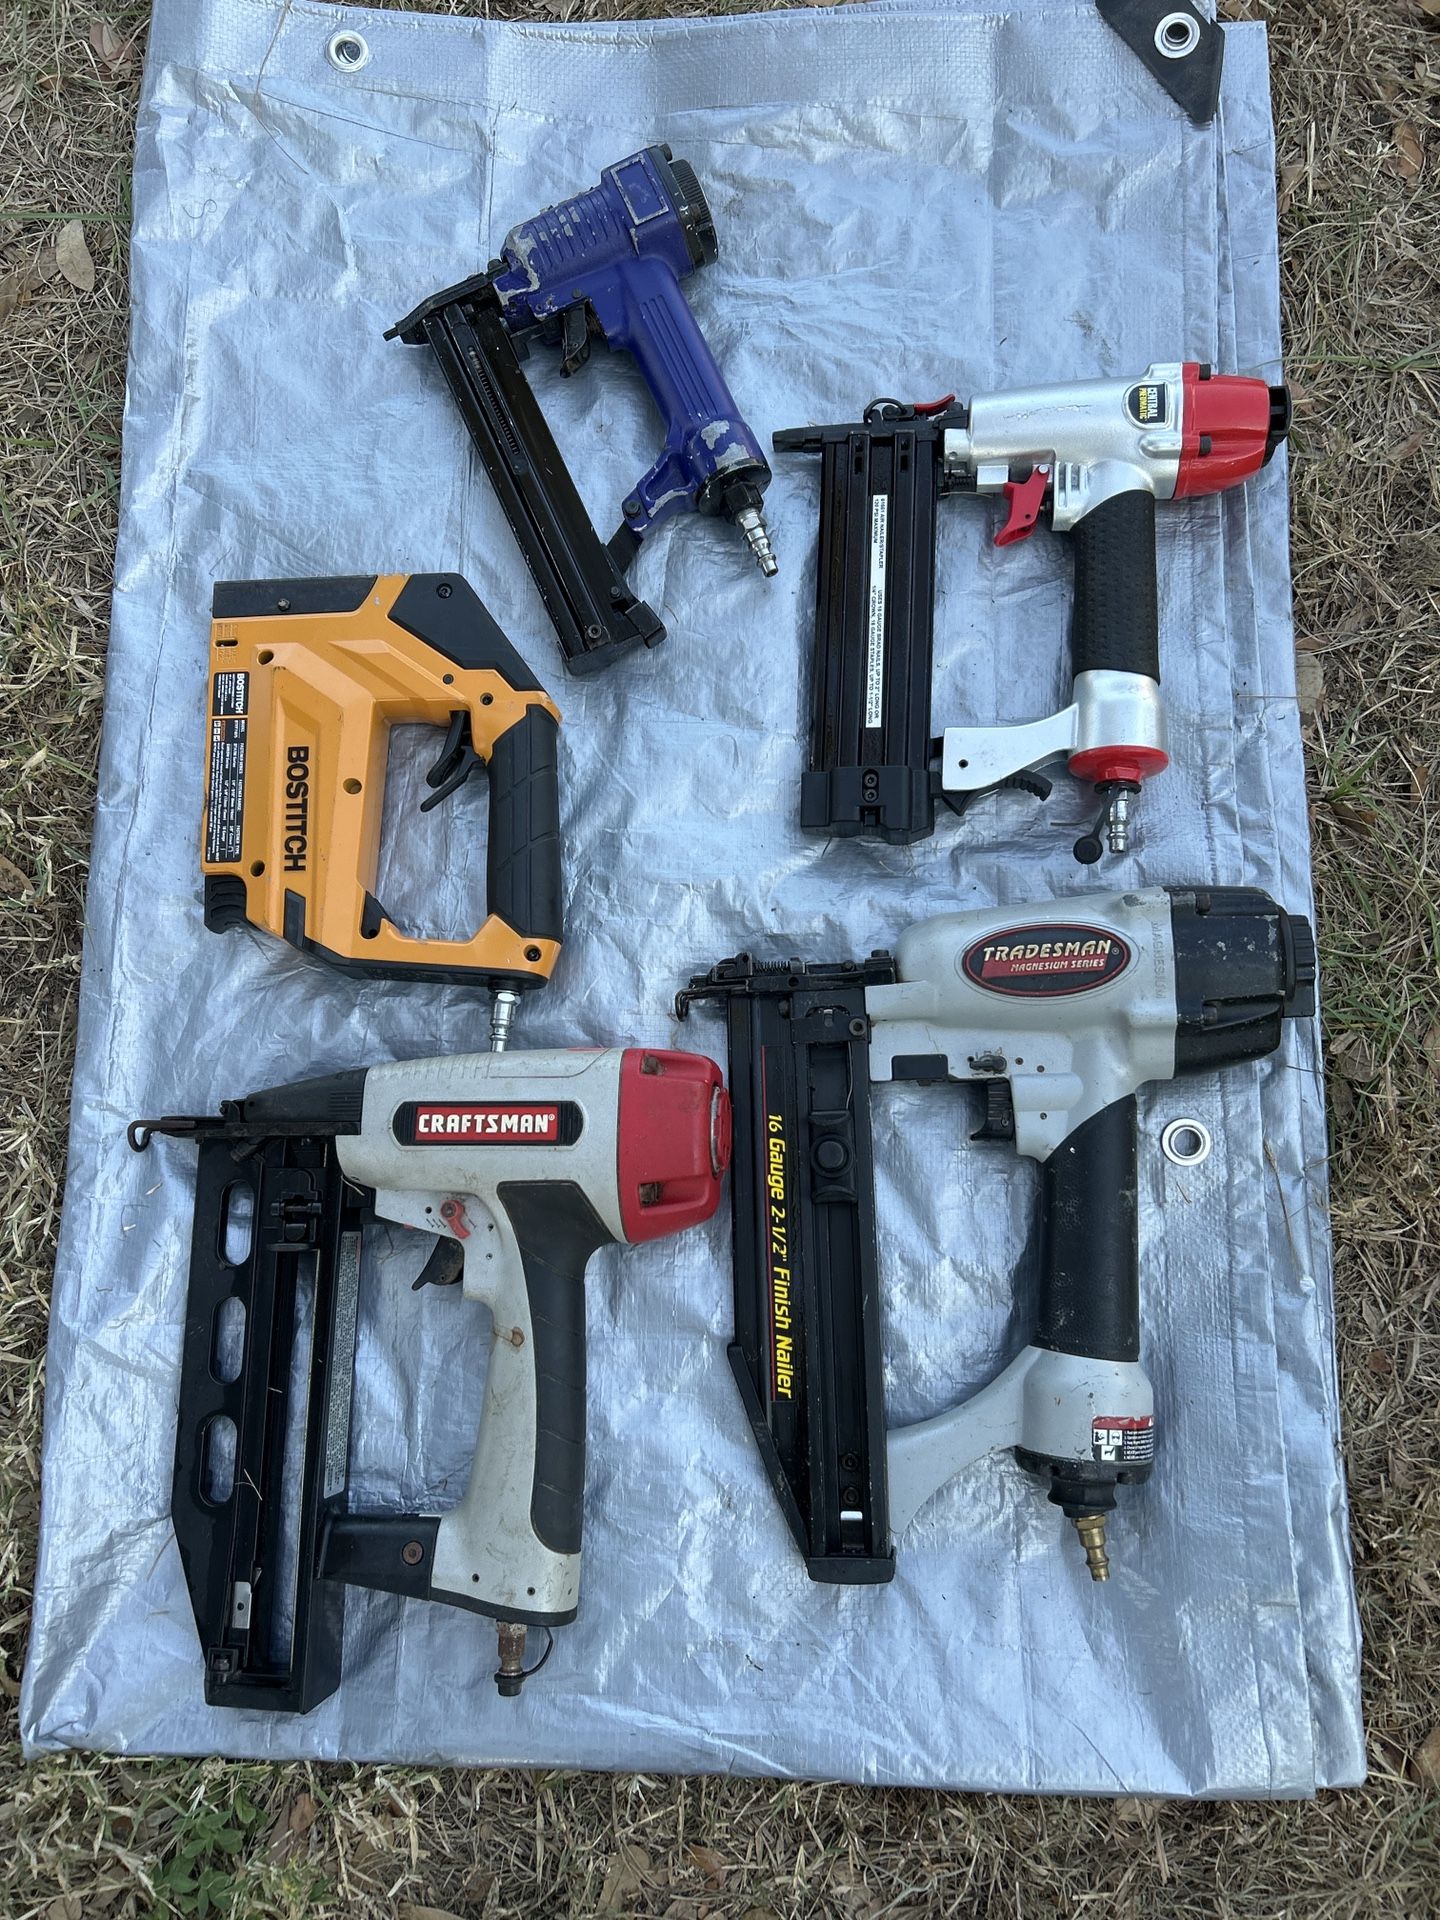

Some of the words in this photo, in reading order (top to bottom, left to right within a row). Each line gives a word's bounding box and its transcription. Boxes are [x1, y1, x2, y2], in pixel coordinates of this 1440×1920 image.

[1138, 387, 1148, 420] PNEUMATIC
[1147, 387, 1158, 419] CENTRAL
[236, 673, 244, 714] BOSTITCH
[284, 746, 309, 871] BOSTITCH
[983, 939, 1112, 962] TRADESMAN
[1010, 960, 1068, 972] MAGNESIUM
[1070, 958, 1105, 969] SERIES
[418, 1113, 550, 1134] CRAFTSMAN
[768, 1114, 783, 1132] 16
[767, 1137, 786, 1200] Gauge
[771, 1205, 787, 1261] 2-1/2"
[774, 1266, 792, 1329] Finish
[776, 1334, 794, 1399] Nailer
